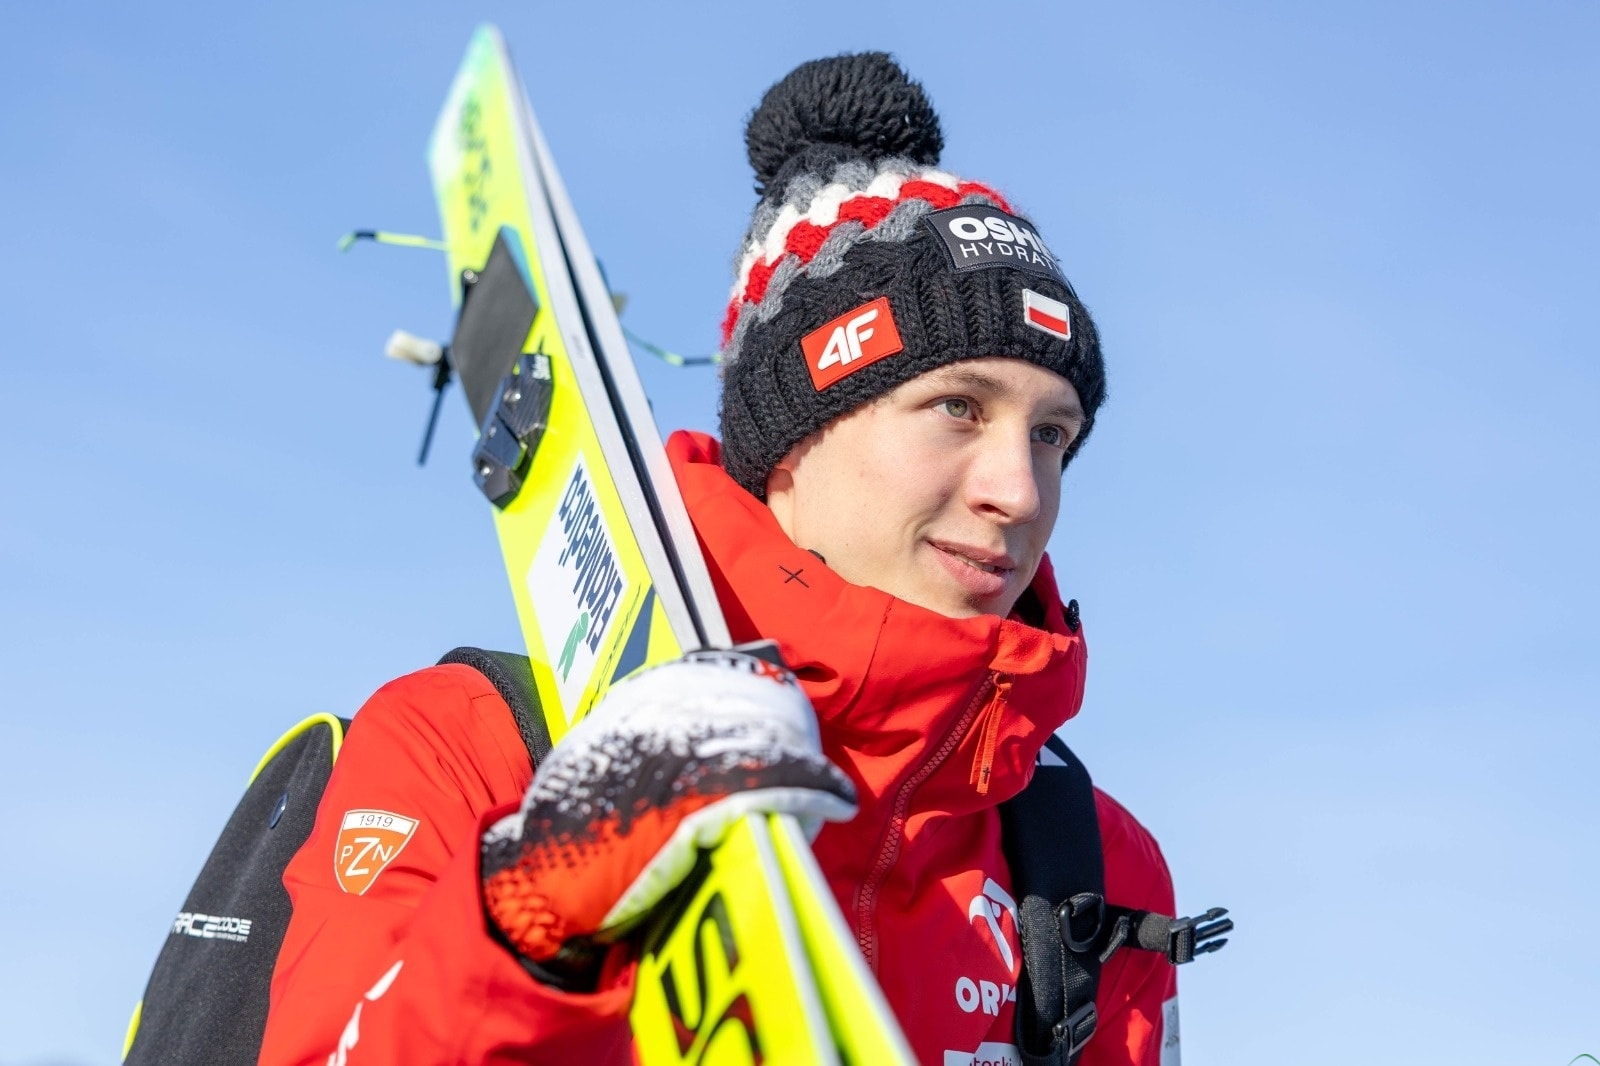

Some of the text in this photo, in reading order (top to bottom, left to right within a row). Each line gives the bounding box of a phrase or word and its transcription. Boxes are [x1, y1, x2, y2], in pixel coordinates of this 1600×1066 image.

[816, 308, 879, 371] 4F
[558, 463, 623, 656] EkaMedica
[359, 814, 394, 828] 1919
[339, 837, 394, 877] PZN
